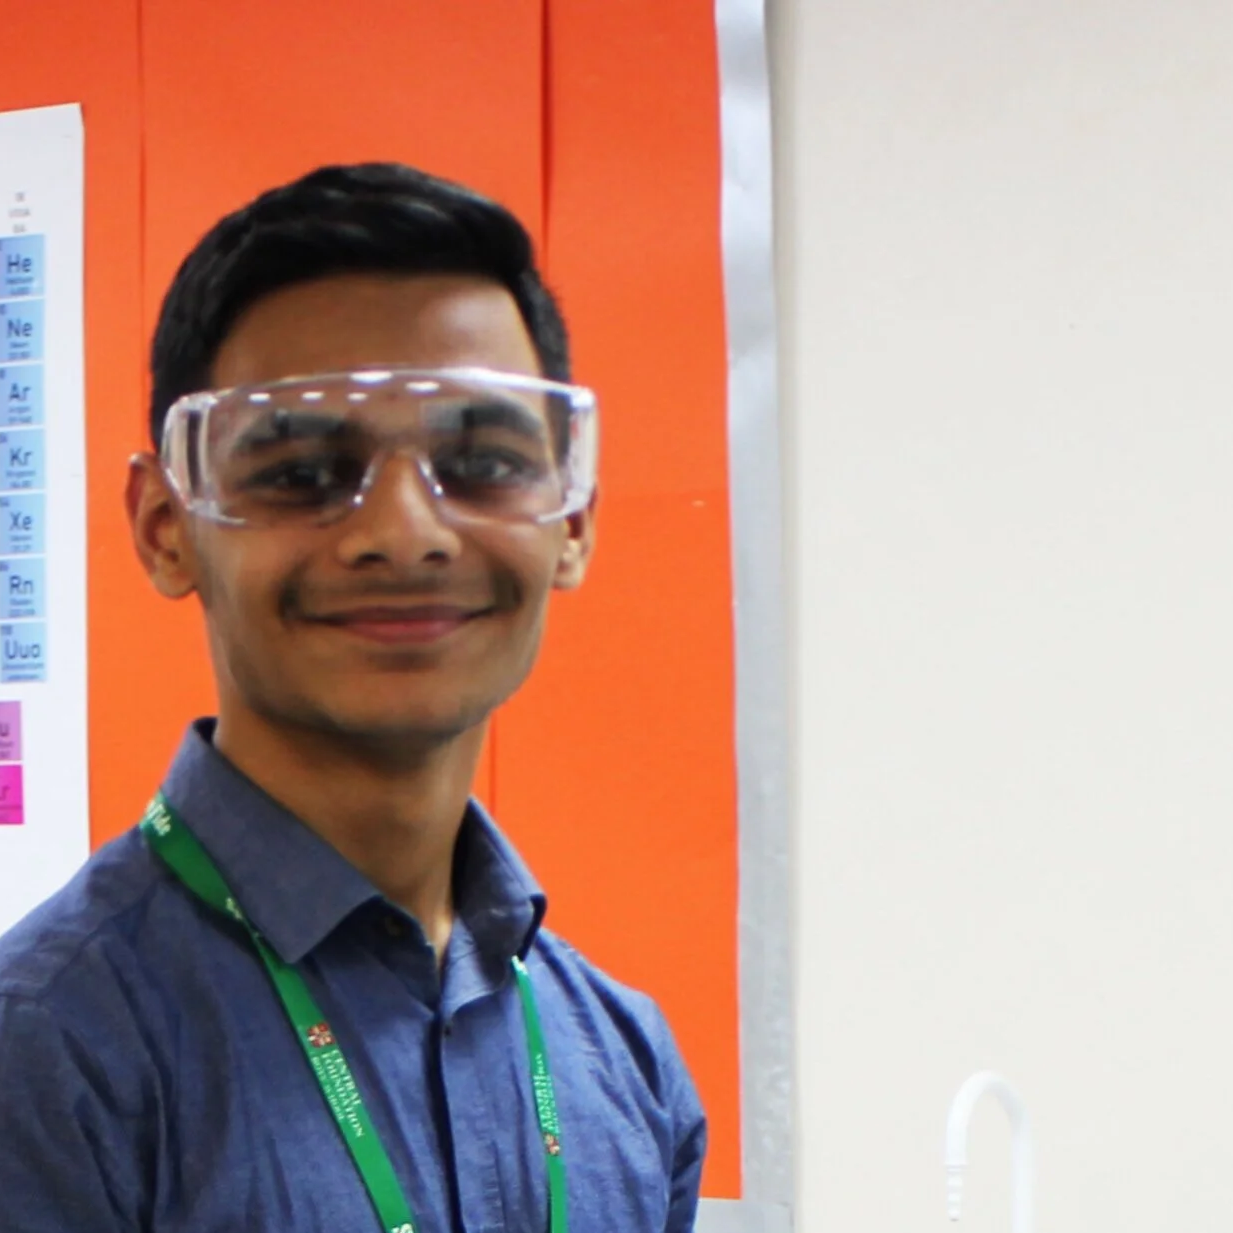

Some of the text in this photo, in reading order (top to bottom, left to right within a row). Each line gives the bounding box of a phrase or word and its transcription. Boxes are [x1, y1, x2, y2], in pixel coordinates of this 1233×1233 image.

[7, 254, 31, 273] He
[7, 319, 32, 337] Ne
[9, 383, 30, 401] Ar
[10, 447, 32, 467] Kr
[10, 512, 32, 531] Xe
[10, 576, 33, 594] Rn
[5, 641, 40, 659] Uuo
[321, 1052, 364, 1137] FOUNDATION
